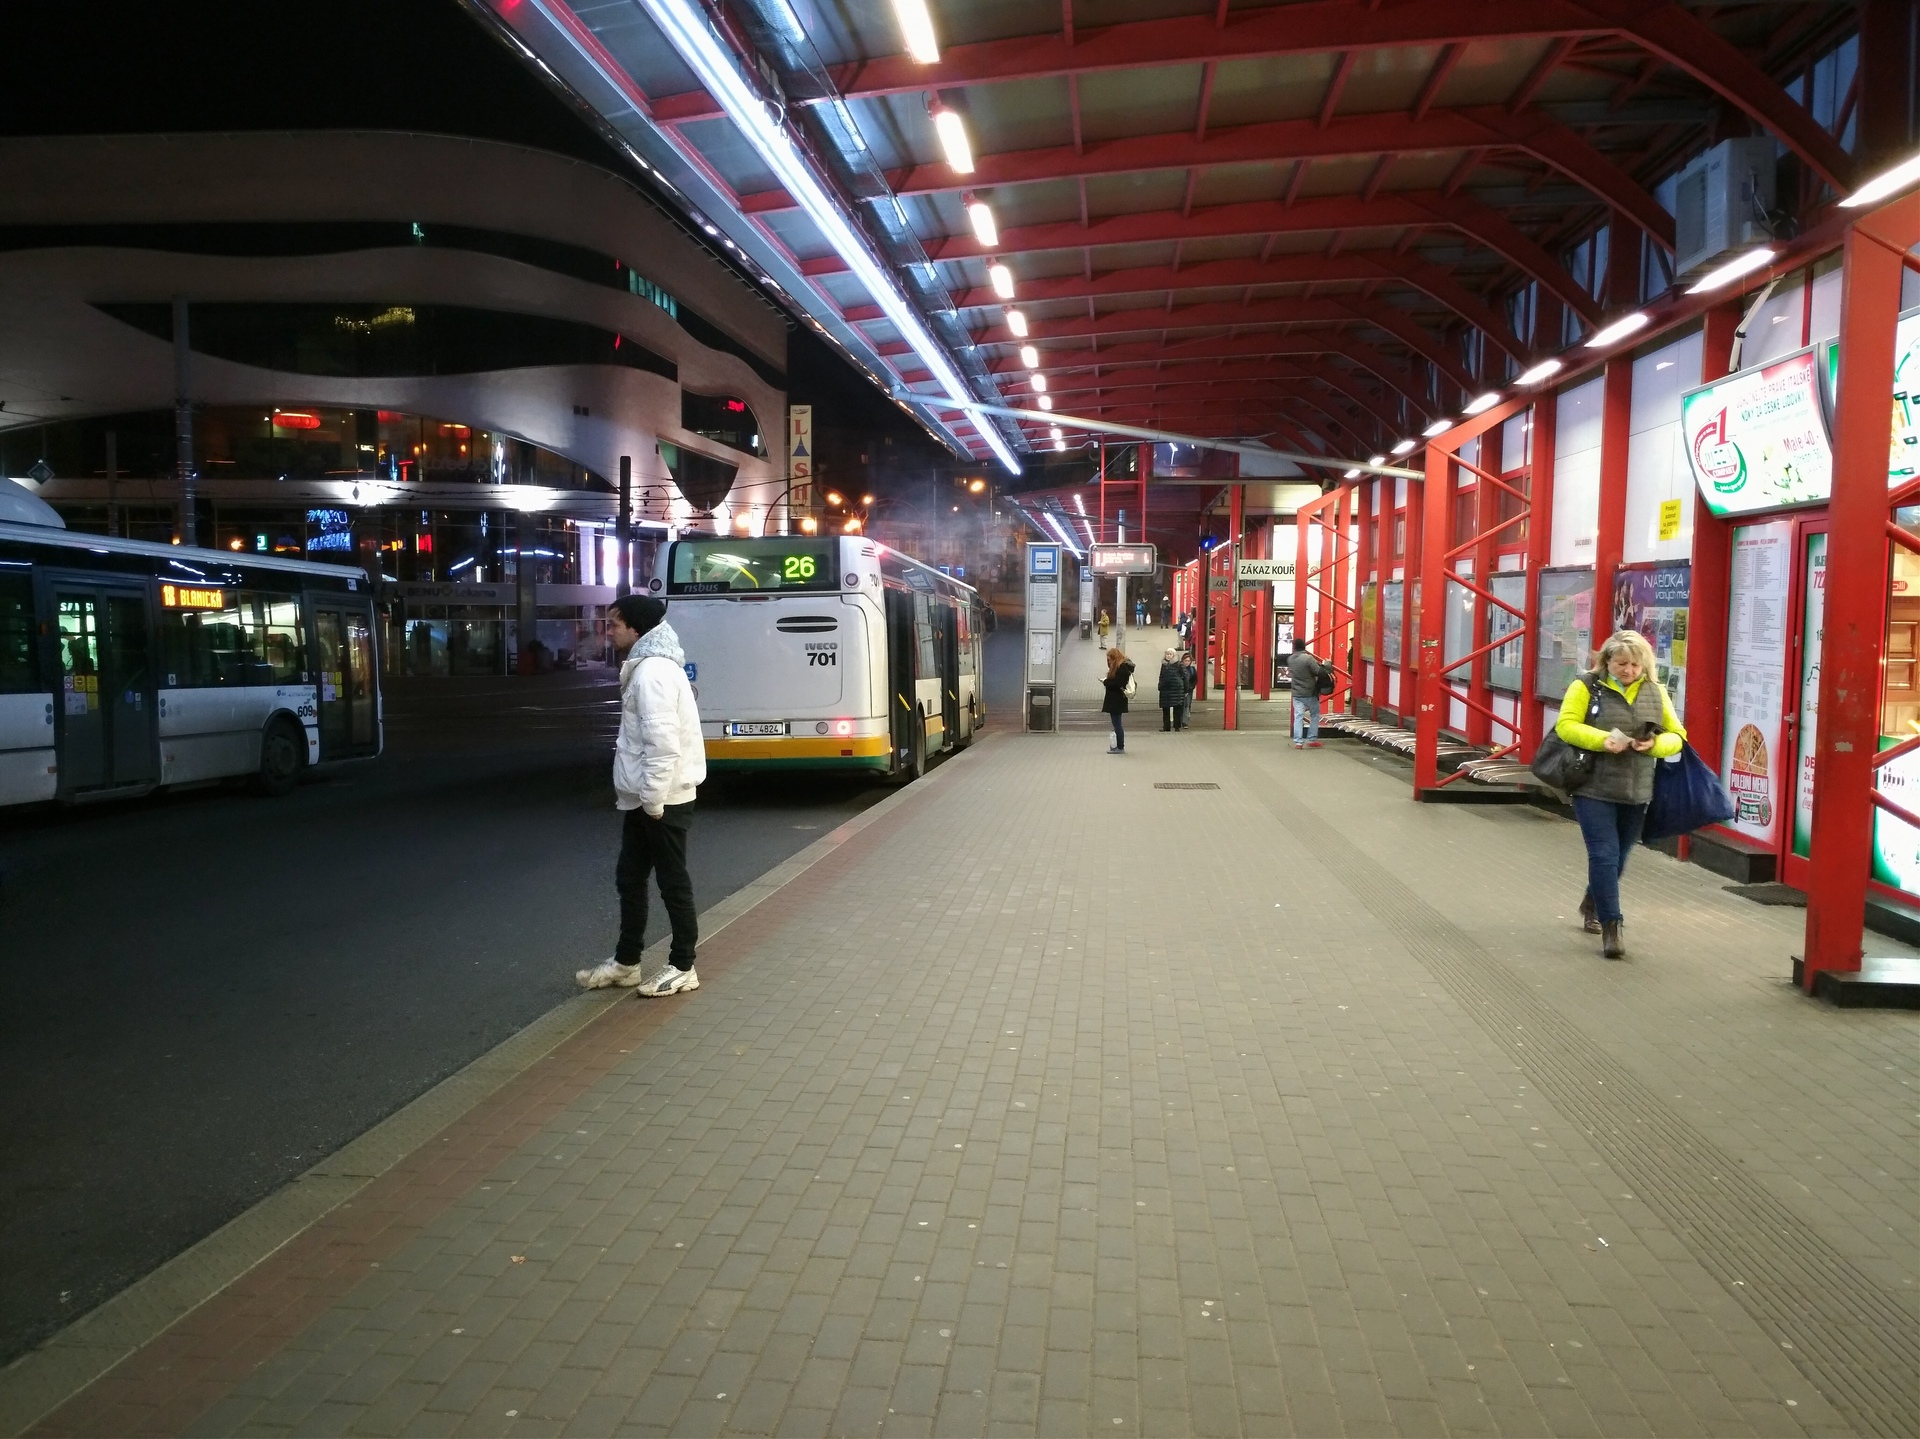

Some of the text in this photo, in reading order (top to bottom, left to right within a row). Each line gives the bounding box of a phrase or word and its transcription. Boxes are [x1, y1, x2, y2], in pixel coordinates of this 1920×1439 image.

[785, 556, 815, 578] 26
[1241, 563, 1299, 575] ZÁKAZ KOUŘ
[683, 583, 719, 593] risbus
[163, 585, 223, 608] 18 BLANICKÁ
[805, 642, 838, 650] IVECO
[807, 652, 836, 666] 701
[297, 705, 313, 717] 609
[739, 725, 779, 733] 4L5 4824
[1731, 773, 1769, 794] POLEDNÍ MENU
